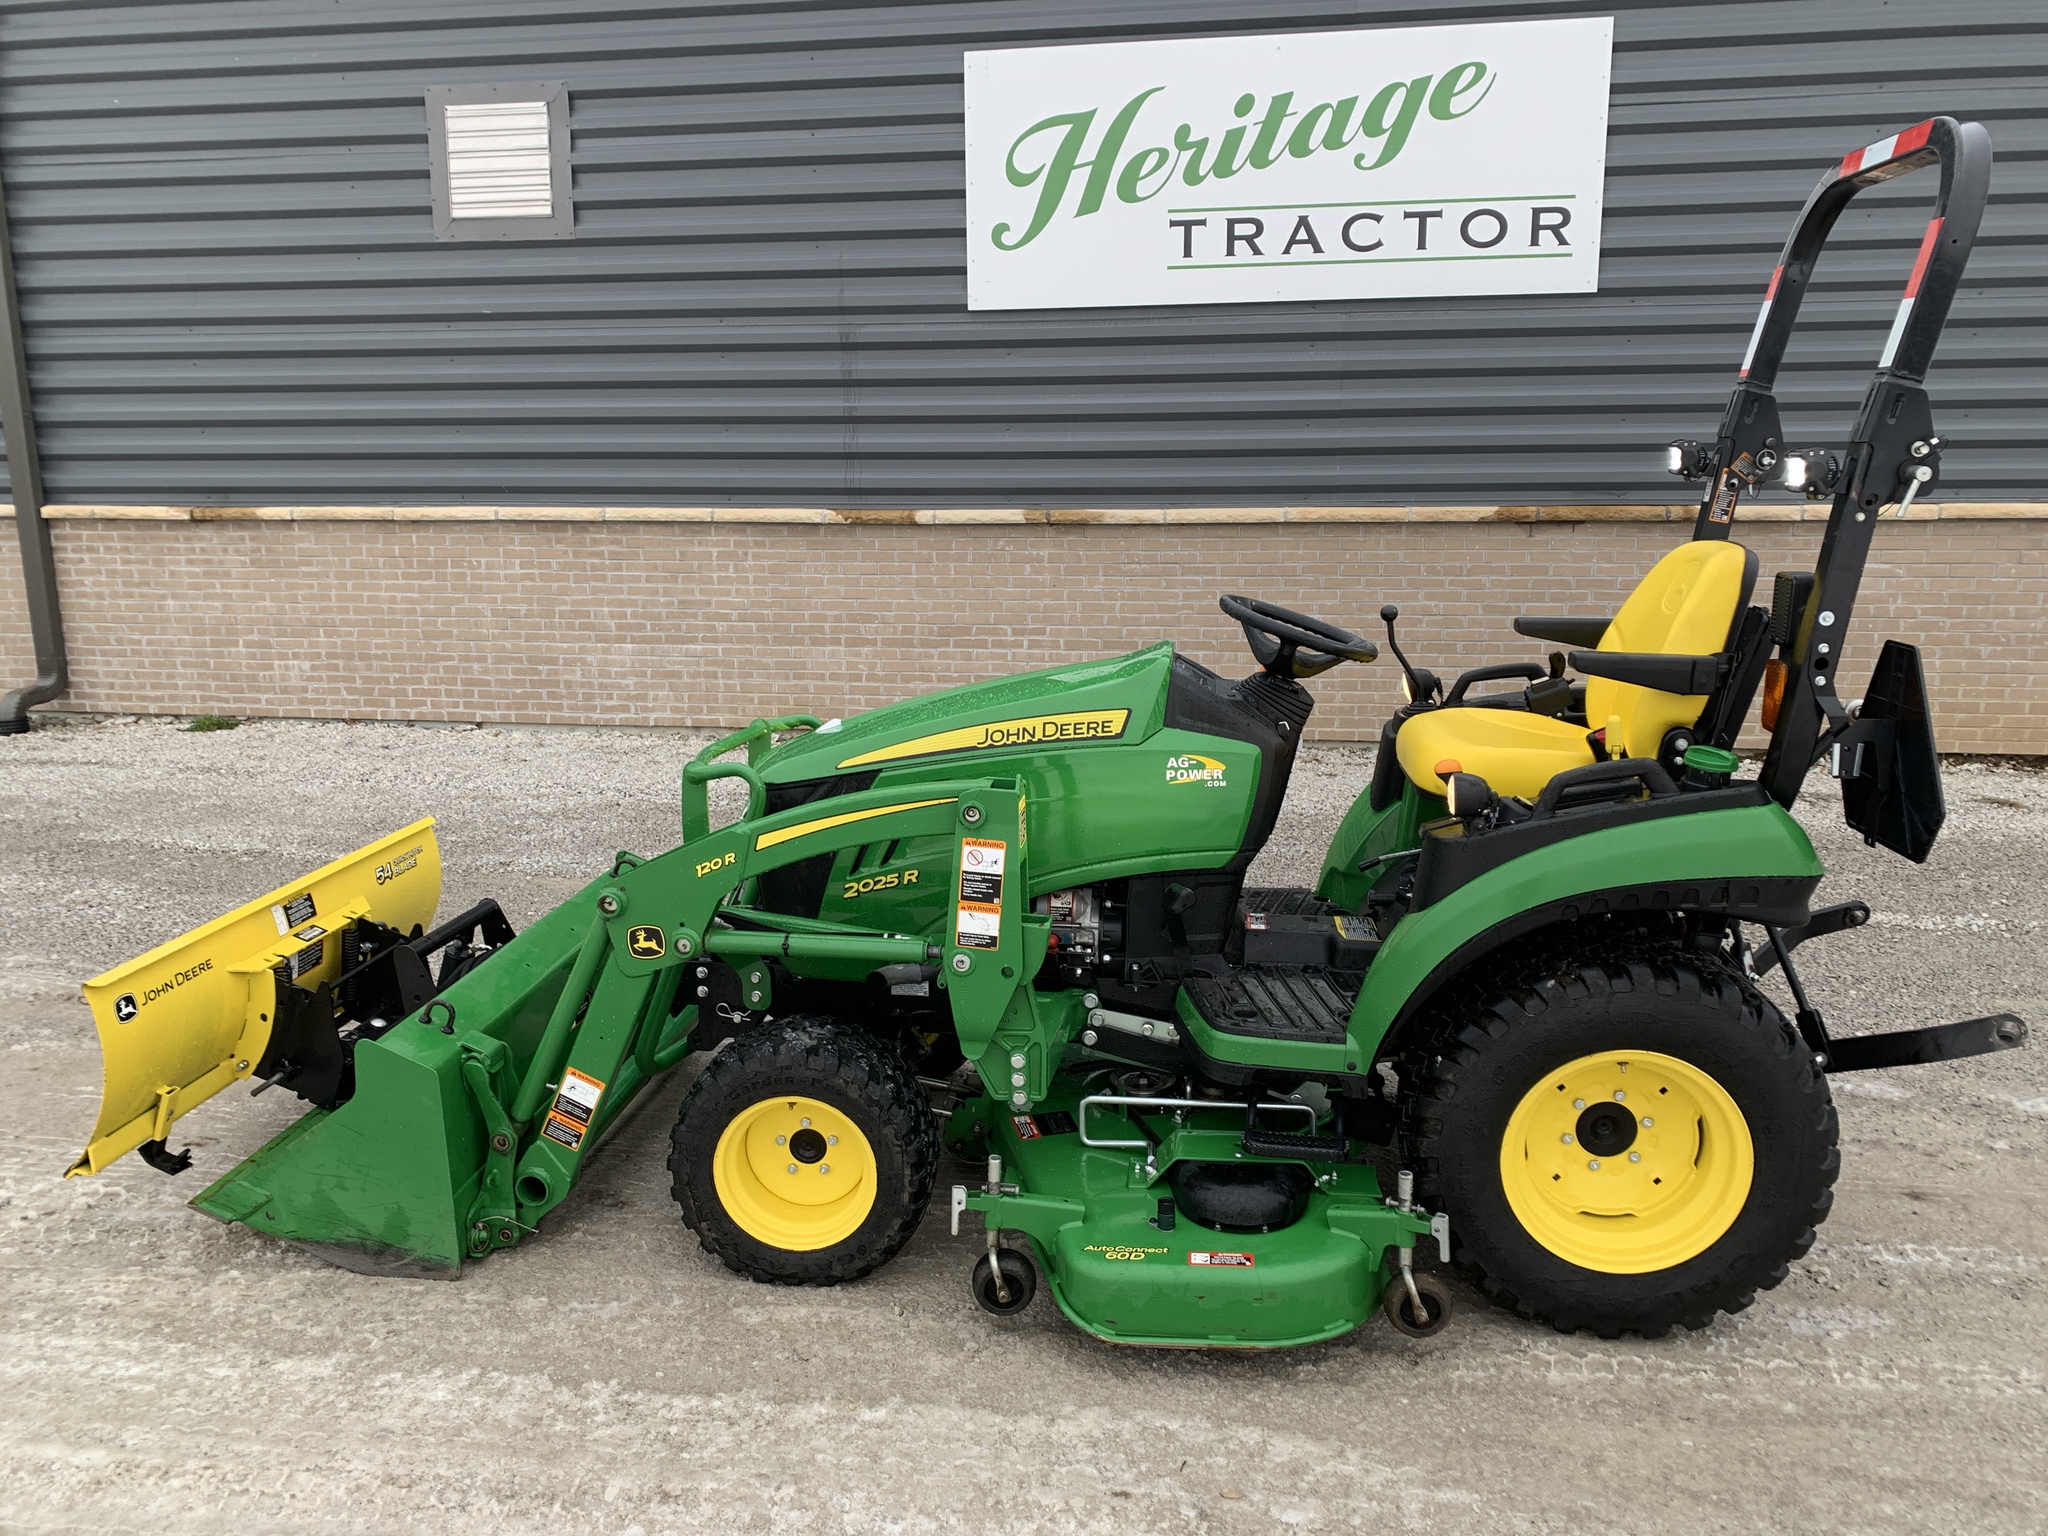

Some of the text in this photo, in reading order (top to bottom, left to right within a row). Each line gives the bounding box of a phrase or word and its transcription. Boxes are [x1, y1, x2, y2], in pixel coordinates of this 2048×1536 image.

[991, 60, 1497, 252] Heritage
[1168, 206, 1572, 258] TRACTOR
[977, 720, 1114, 746] JOHN DEERE
[1165, 769, 1223, 781] POWER
[1166, 757, 1197, 768] AG-
[971, 840, 1004, 849] WARNING
[375, 862, 393, 886] 54
[695, 852, 737, 878] 120 R
[842, 869, 920, 899] 2025 R
[967, 904, 999, 913] WARNING
[141, 958, 213, 1006] JOHN DEERE
[1104, 1251, 1146, 1261] 60D
